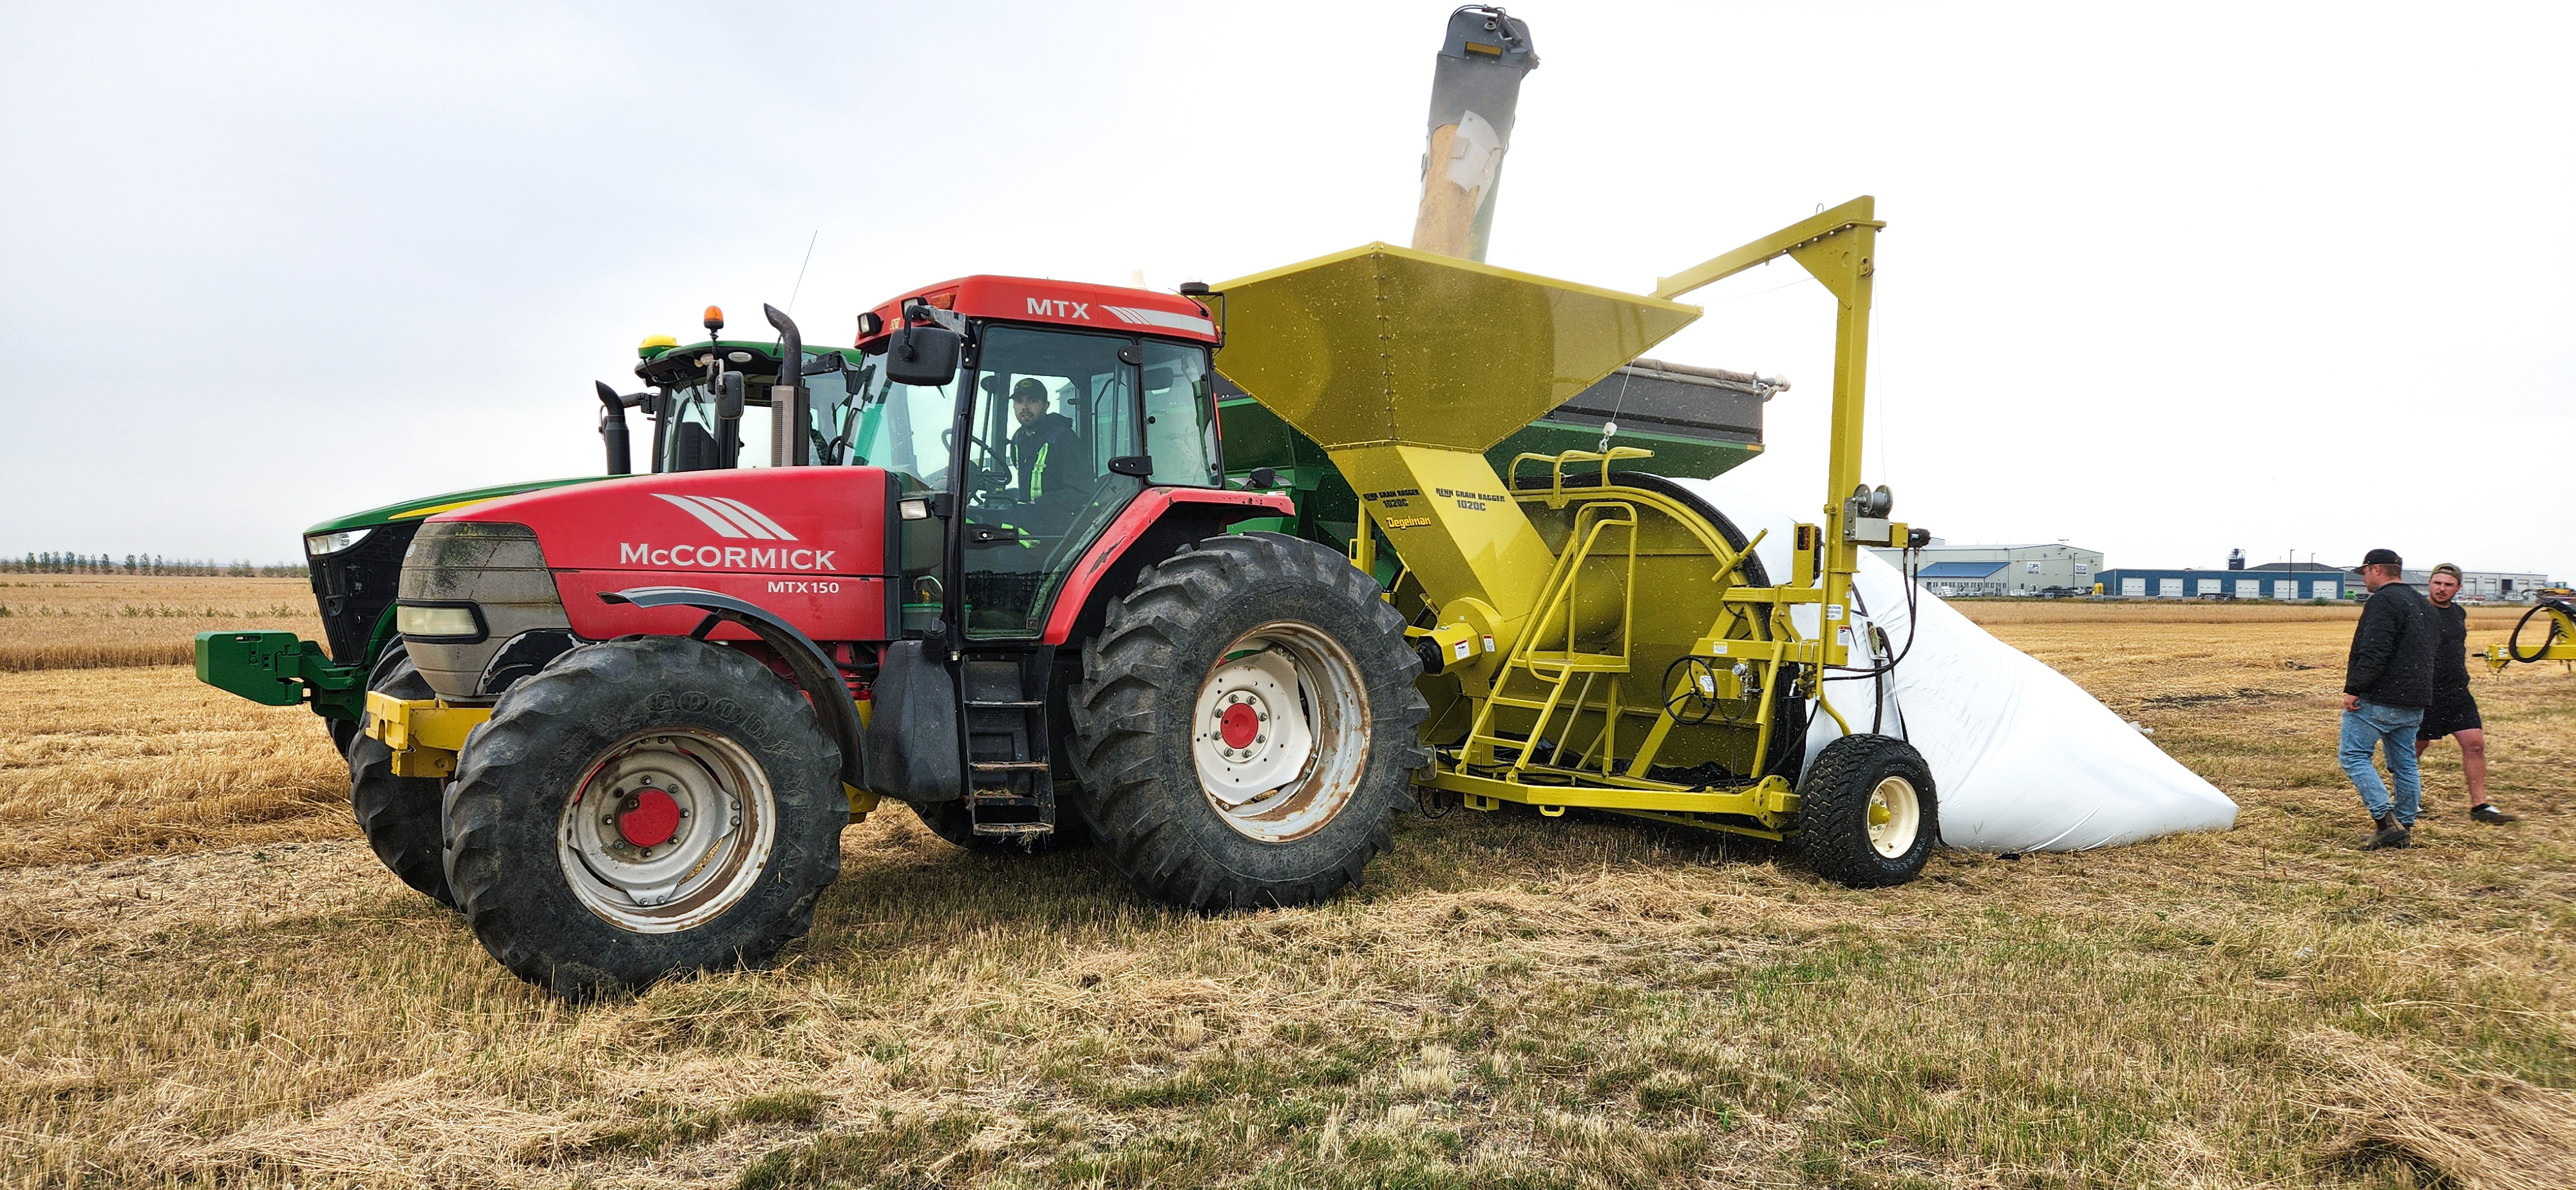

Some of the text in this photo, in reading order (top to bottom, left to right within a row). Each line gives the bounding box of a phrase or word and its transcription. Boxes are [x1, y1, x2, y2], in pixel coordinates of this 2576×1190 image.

[1027, 298, 1090, 320] MTX
[1363, 492, 1378, 502] RENN
[1435, 487, 1505, 502] RENN GRAIN BAGGER
[1383, 498, 1408, 508] 1020C
[1457, 499, 1486, 511] 1020C
[1385, 515, 1432, 530] Degelman
[620, 543, 837, 571] McCORMICK
